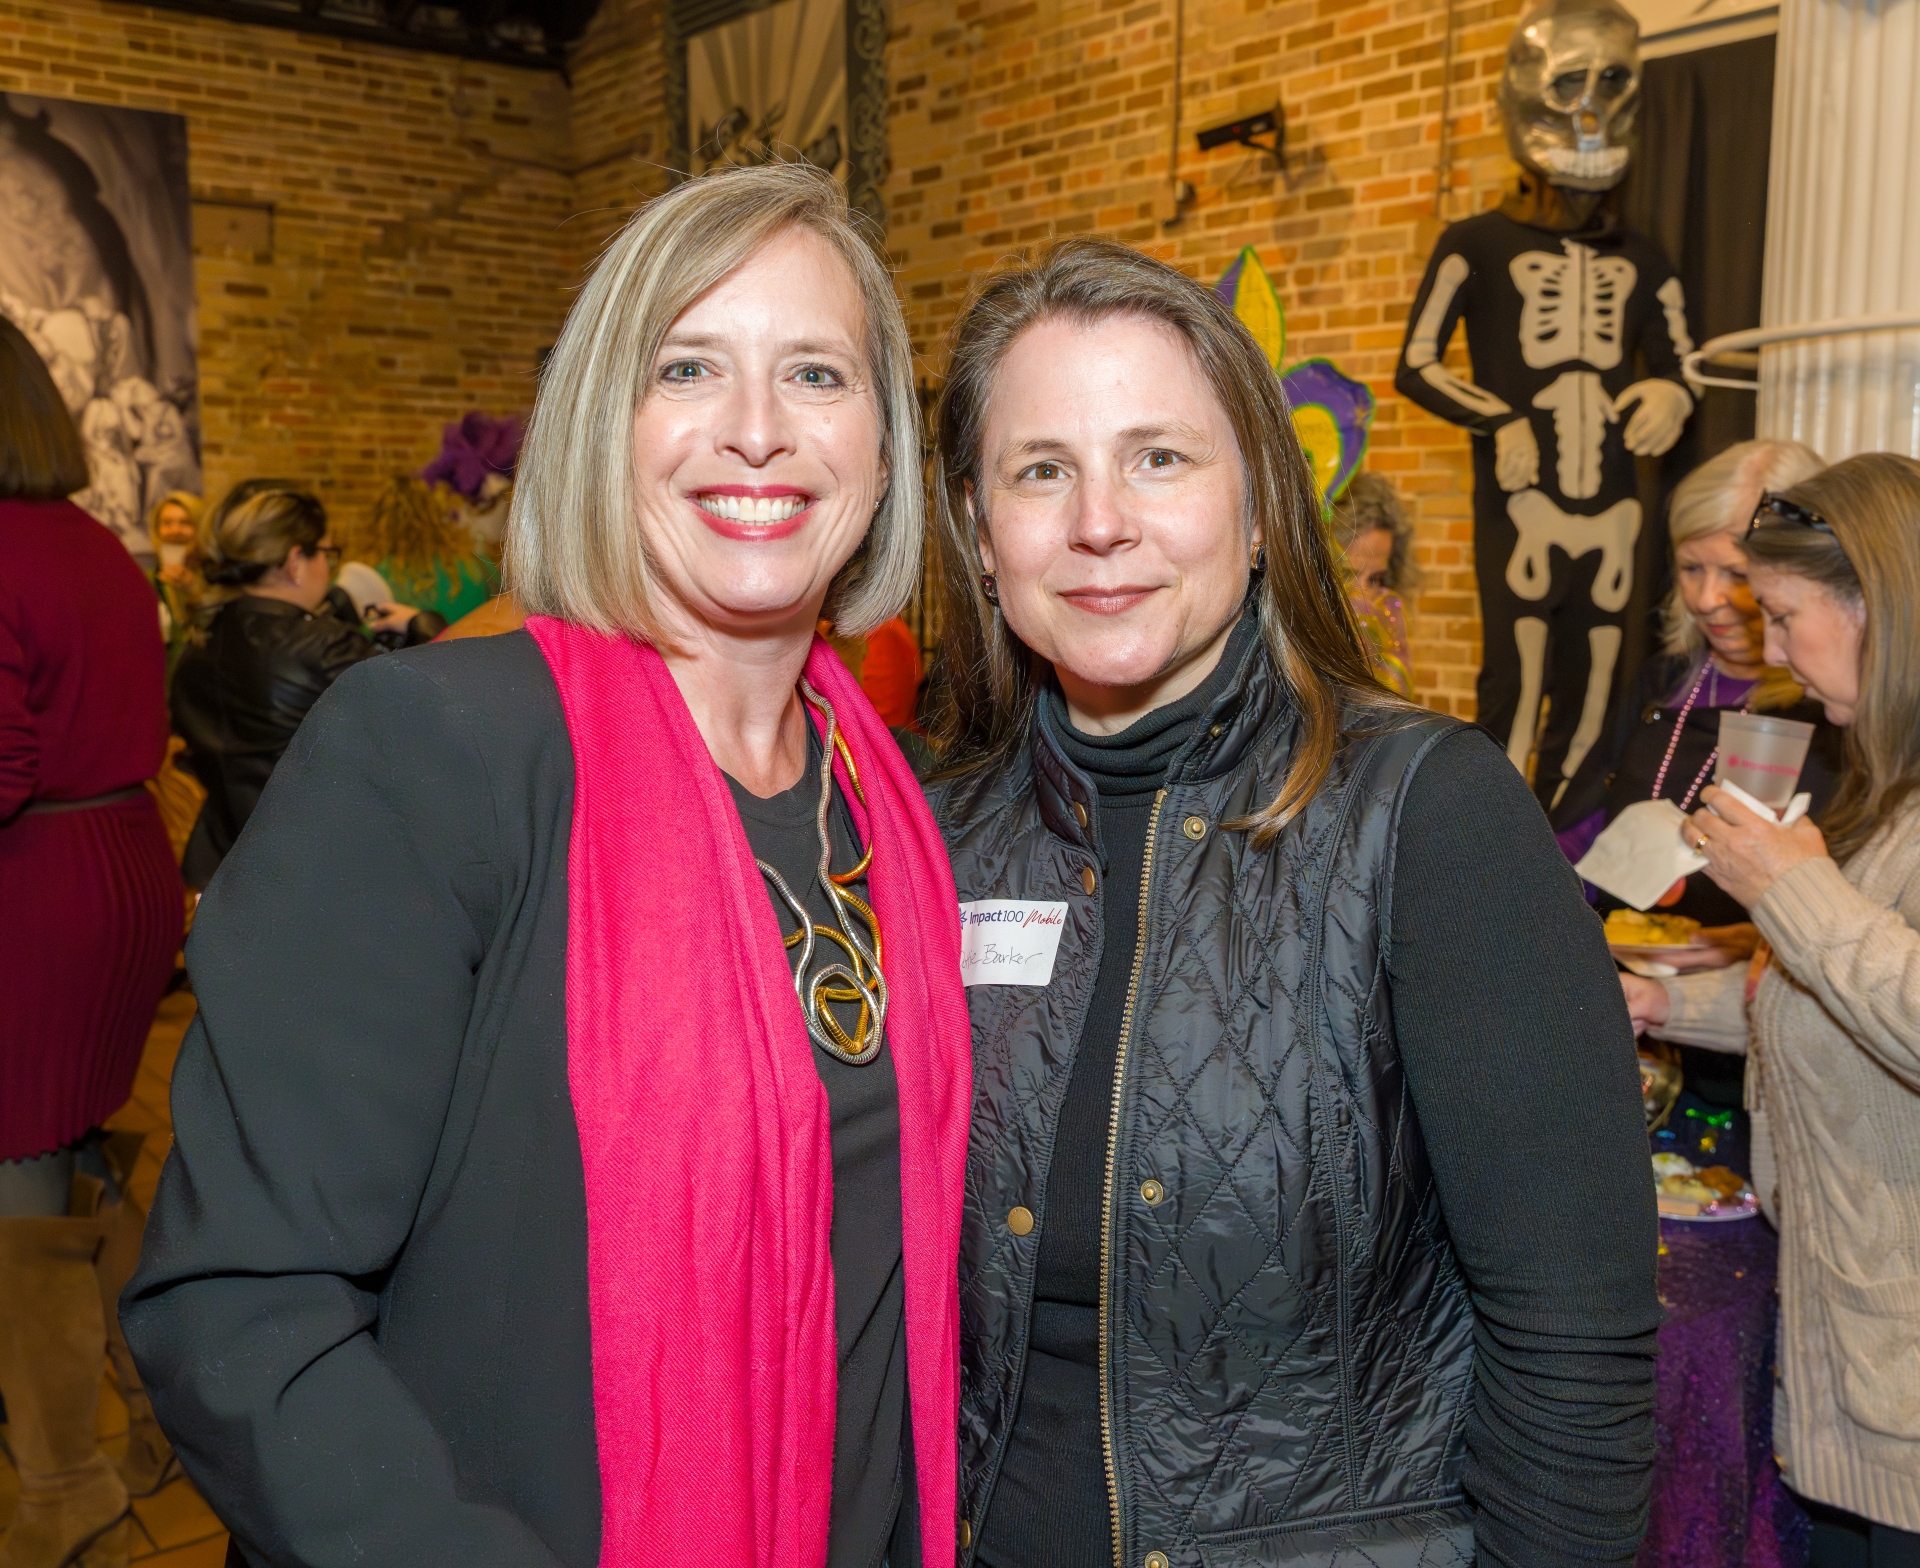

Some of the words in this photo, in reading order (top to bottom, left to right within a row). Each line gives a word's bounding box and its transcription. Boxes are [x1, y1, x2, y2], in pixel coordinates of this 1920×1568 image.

[970, 910, 1023, 926] Impact100
[1022, 908, 1062, 928] Mobile
[982, 943, 1043, 965] Barker
